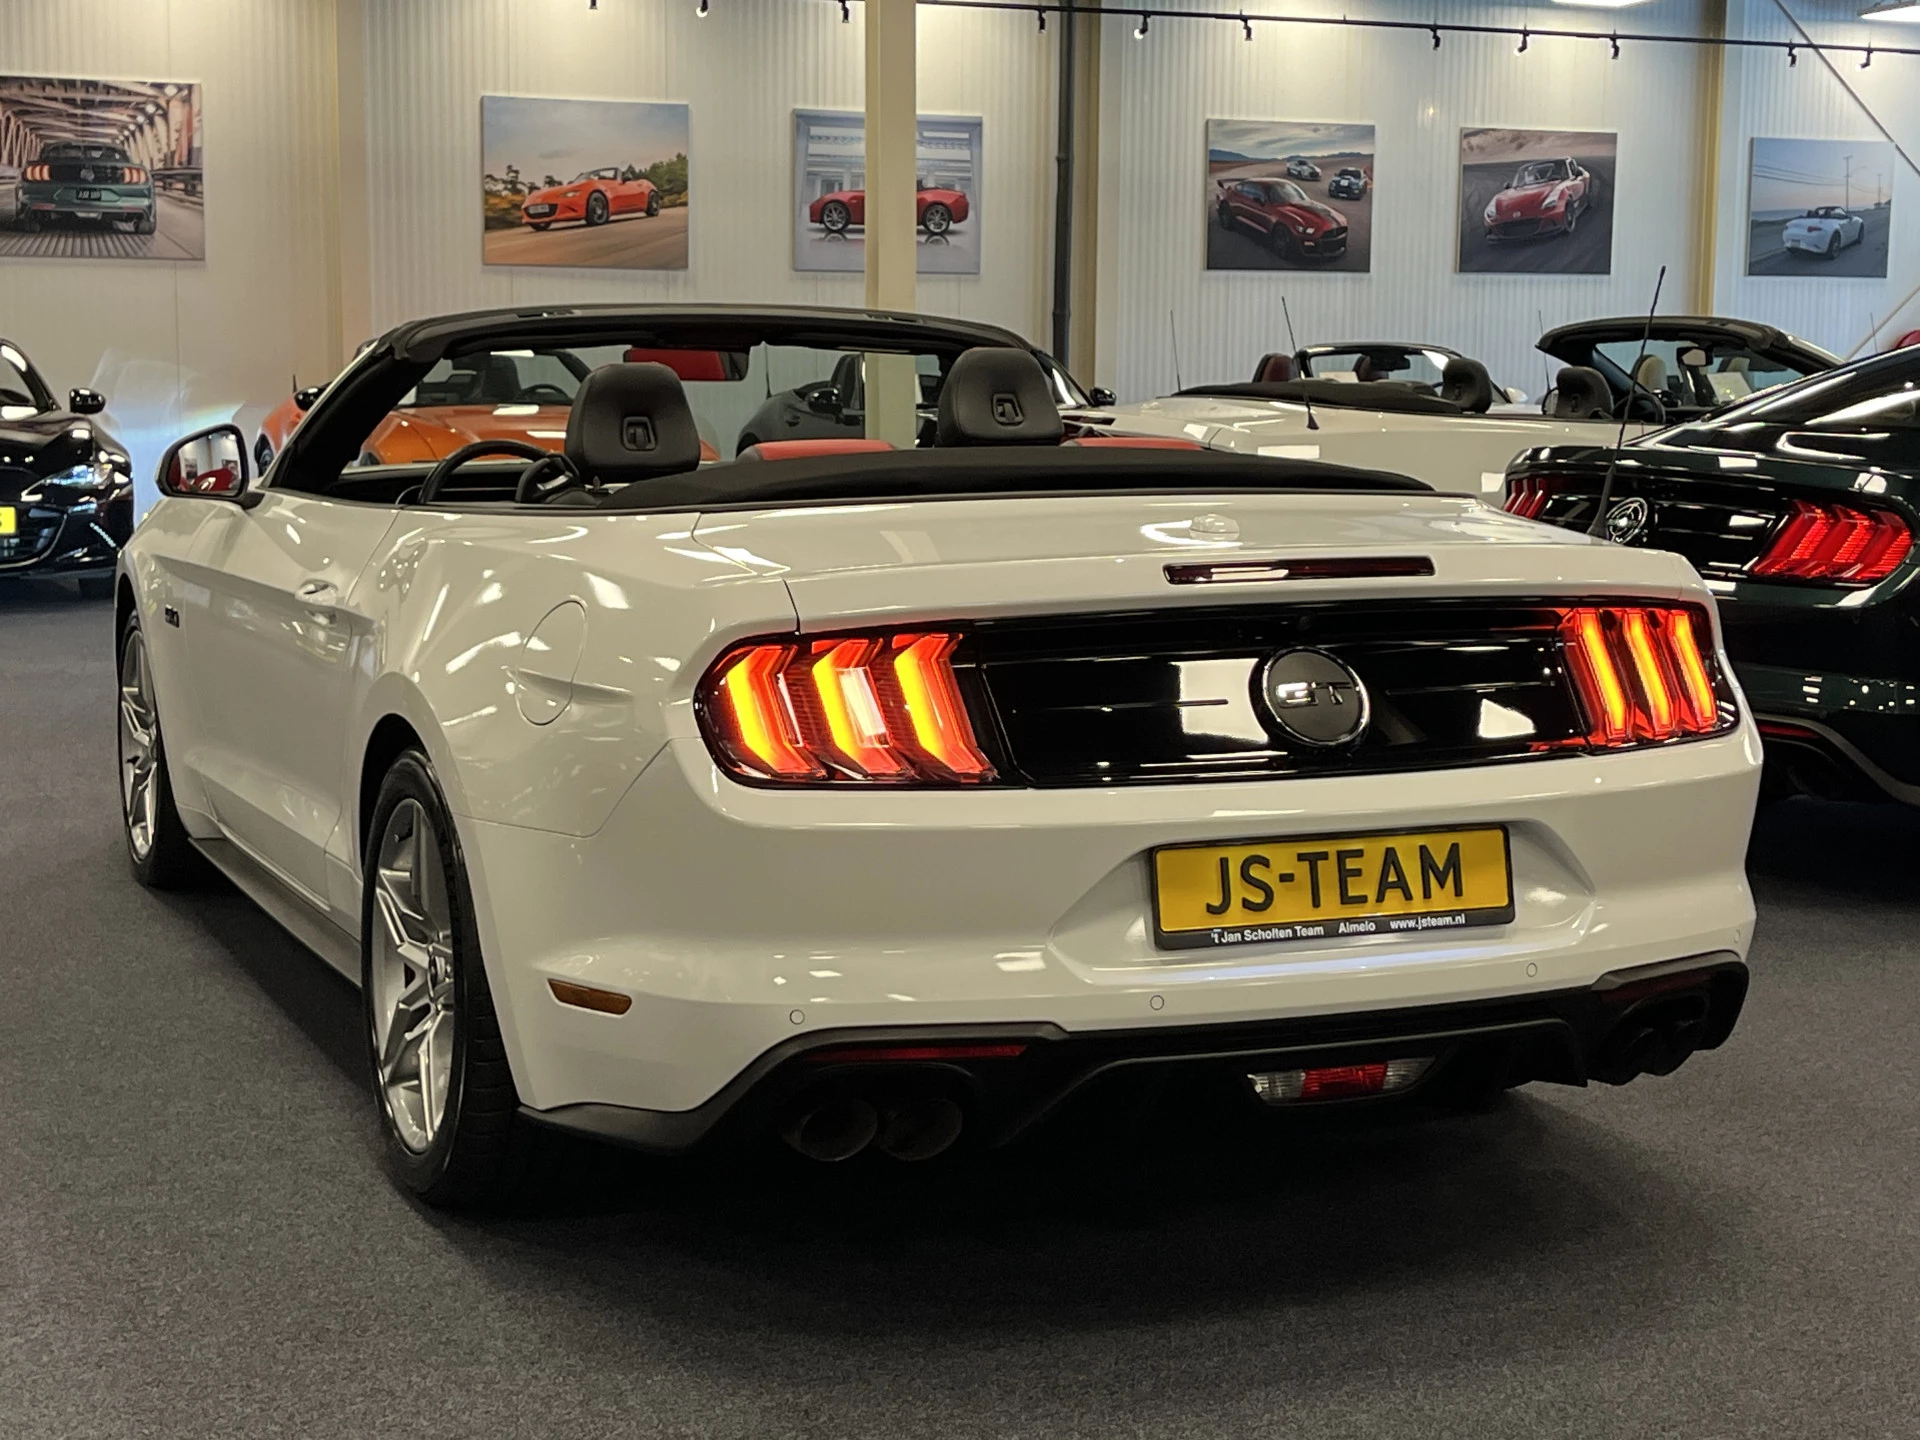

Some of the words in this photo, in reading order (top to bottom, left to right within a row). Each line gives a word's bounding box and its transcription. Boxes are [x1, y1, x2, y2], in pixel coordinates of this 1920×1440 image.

[1276, 682, 1352, 709] GT
[1206, 842, 1463, 915] JS-TEAM
[1221, 931, 1242, 943] Jan
[1244, 928, 1293, 941] Scholten
[1294, 926, 1324, 937] Team
[1338, 920, 1376, 934] Almelo
[1389, 913, 1466, 929] www.jsteam.nl
